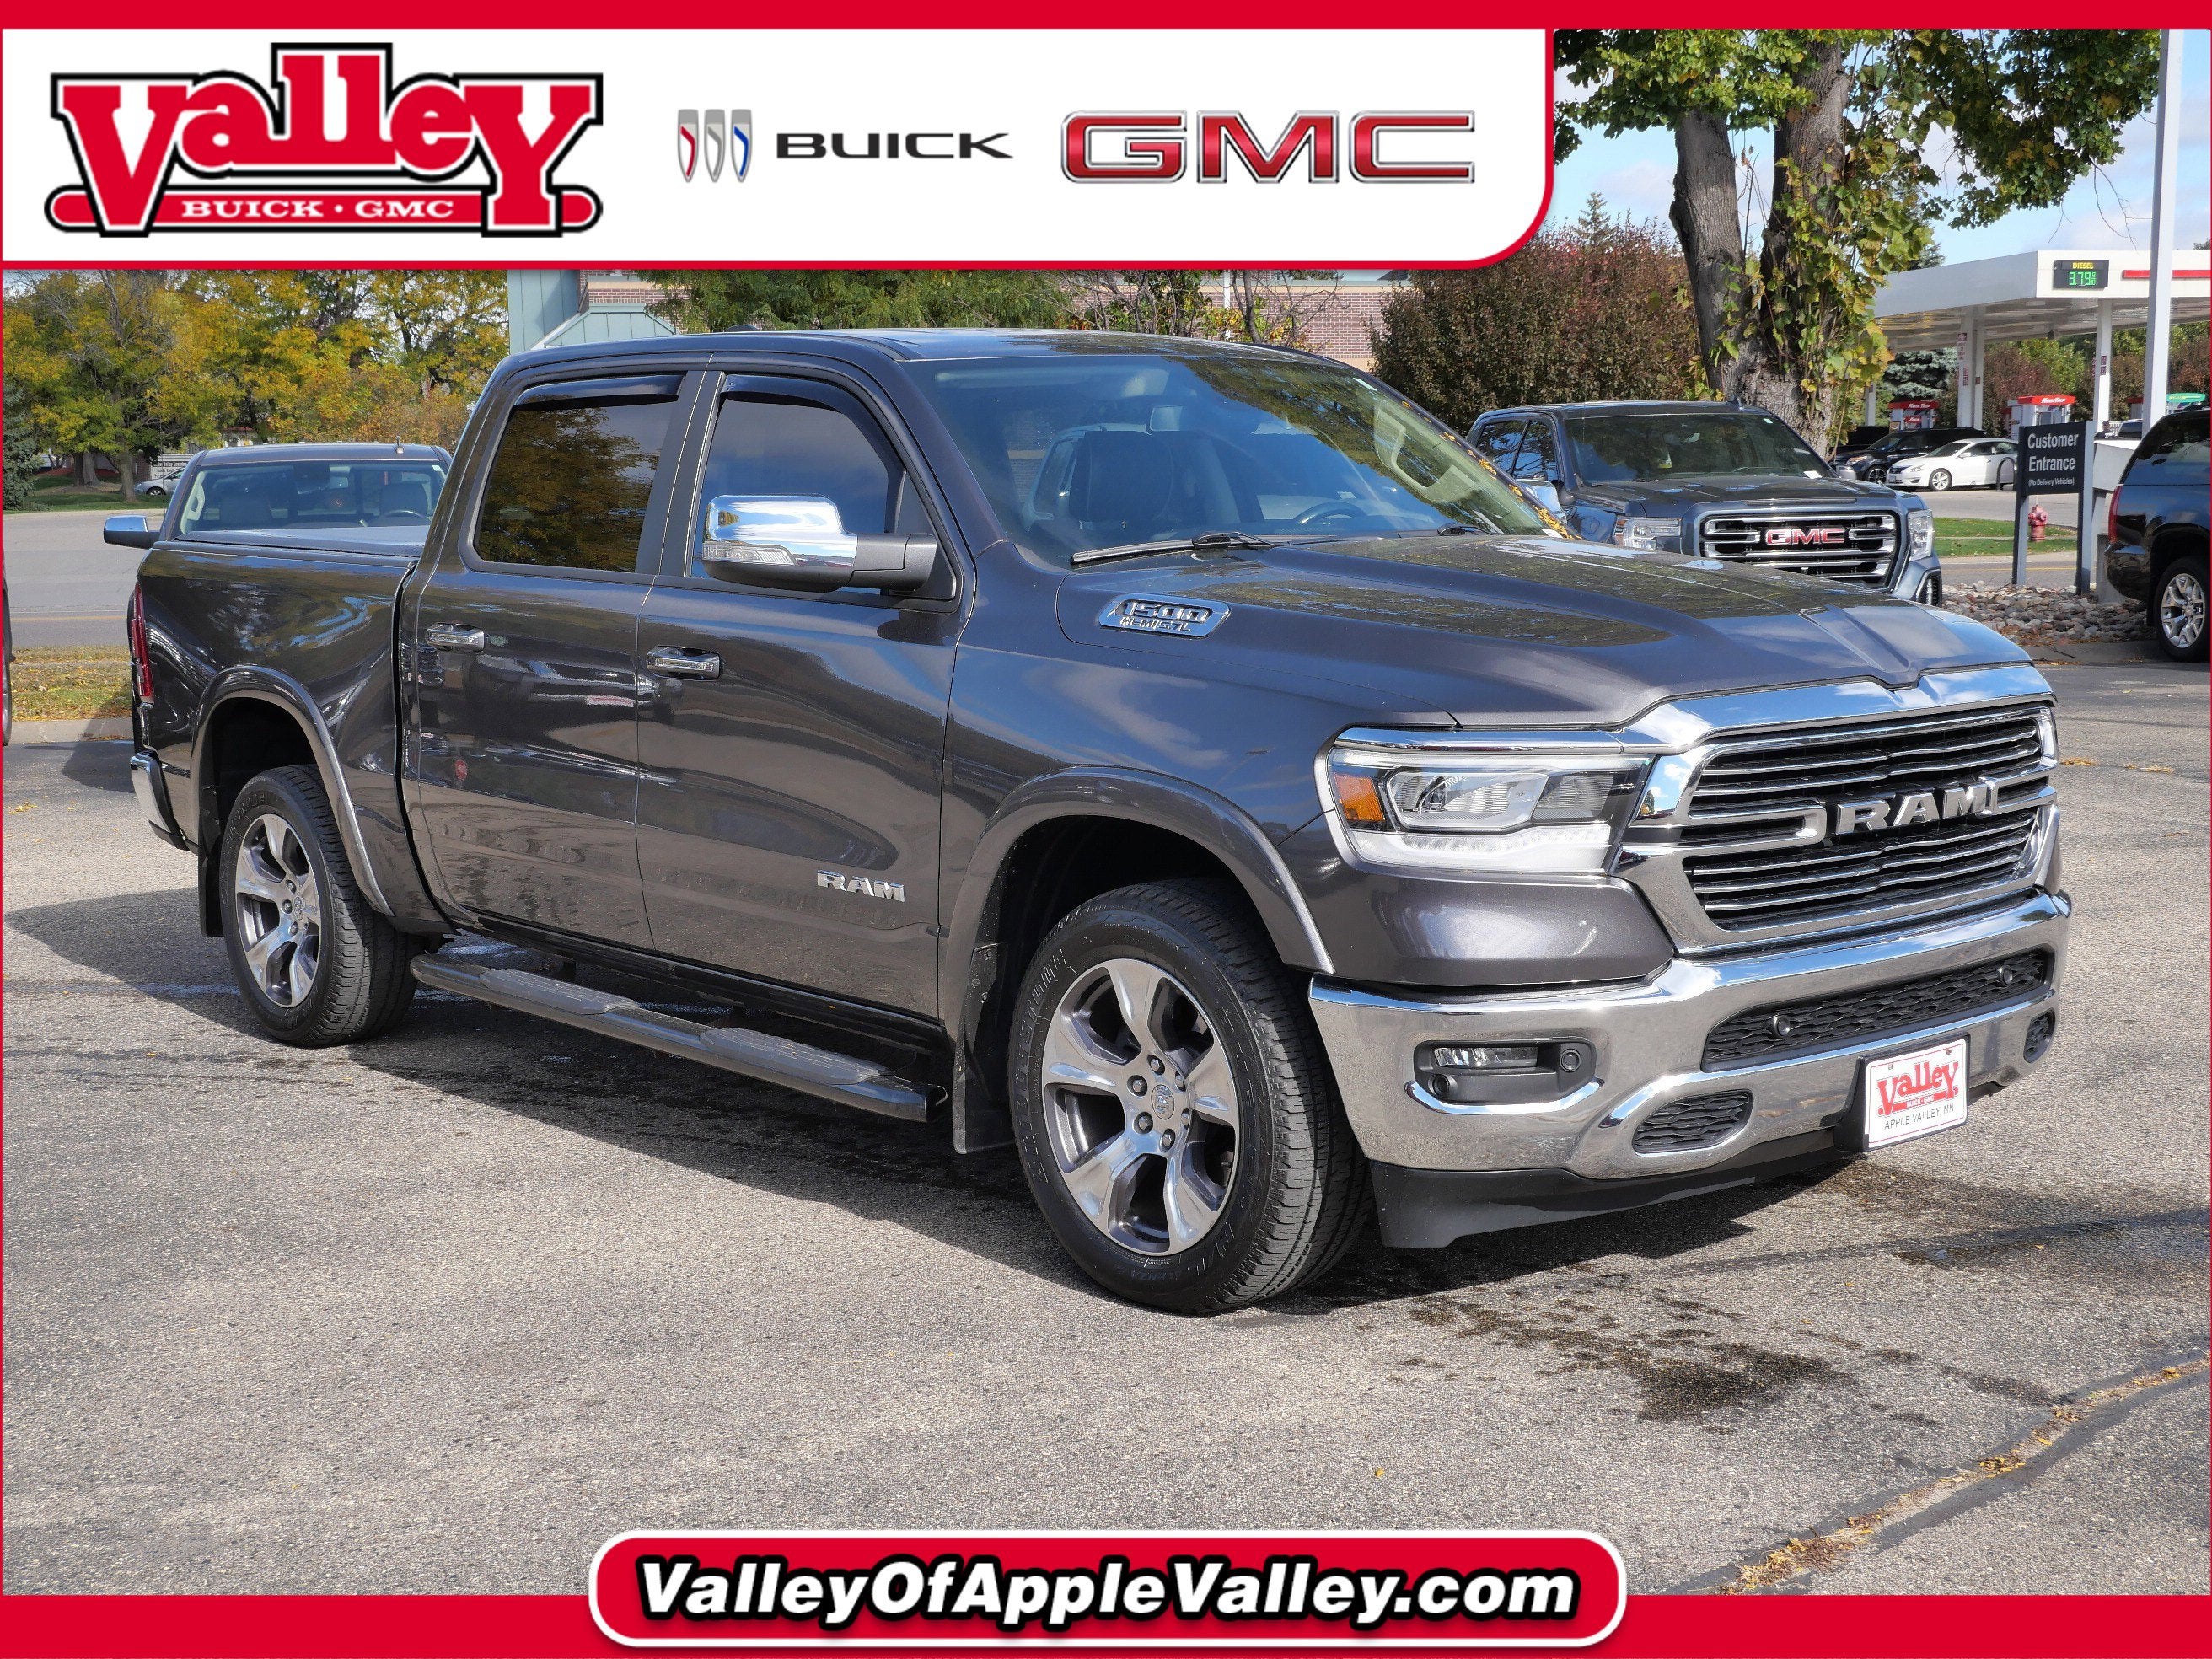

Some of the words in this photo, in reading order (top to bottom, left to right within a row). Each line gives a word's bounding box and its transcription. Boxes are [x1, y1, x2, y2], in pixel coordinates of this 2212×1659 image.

[2027, 432, 2080, 449] Customer
[2028, 455, 2076, 472] Entrance
[2028, 478, 2037, 487] (No
[2037, 477, 2054, 486] Delivery
[2054, 476, 2075, 486] Vehicles)
[1765, 528, 1845, 545] GMC
[1123, 601, 1211, 624] 1500
[1834, 782, 1991, 835] RAM
[817, 869, 905, 903] RAM
[1876, 1060, 1959, 1116] Valley
[1884, 1114, 1910, 1130] APPLE
[1943, 1103, 1954, 1116] MN
